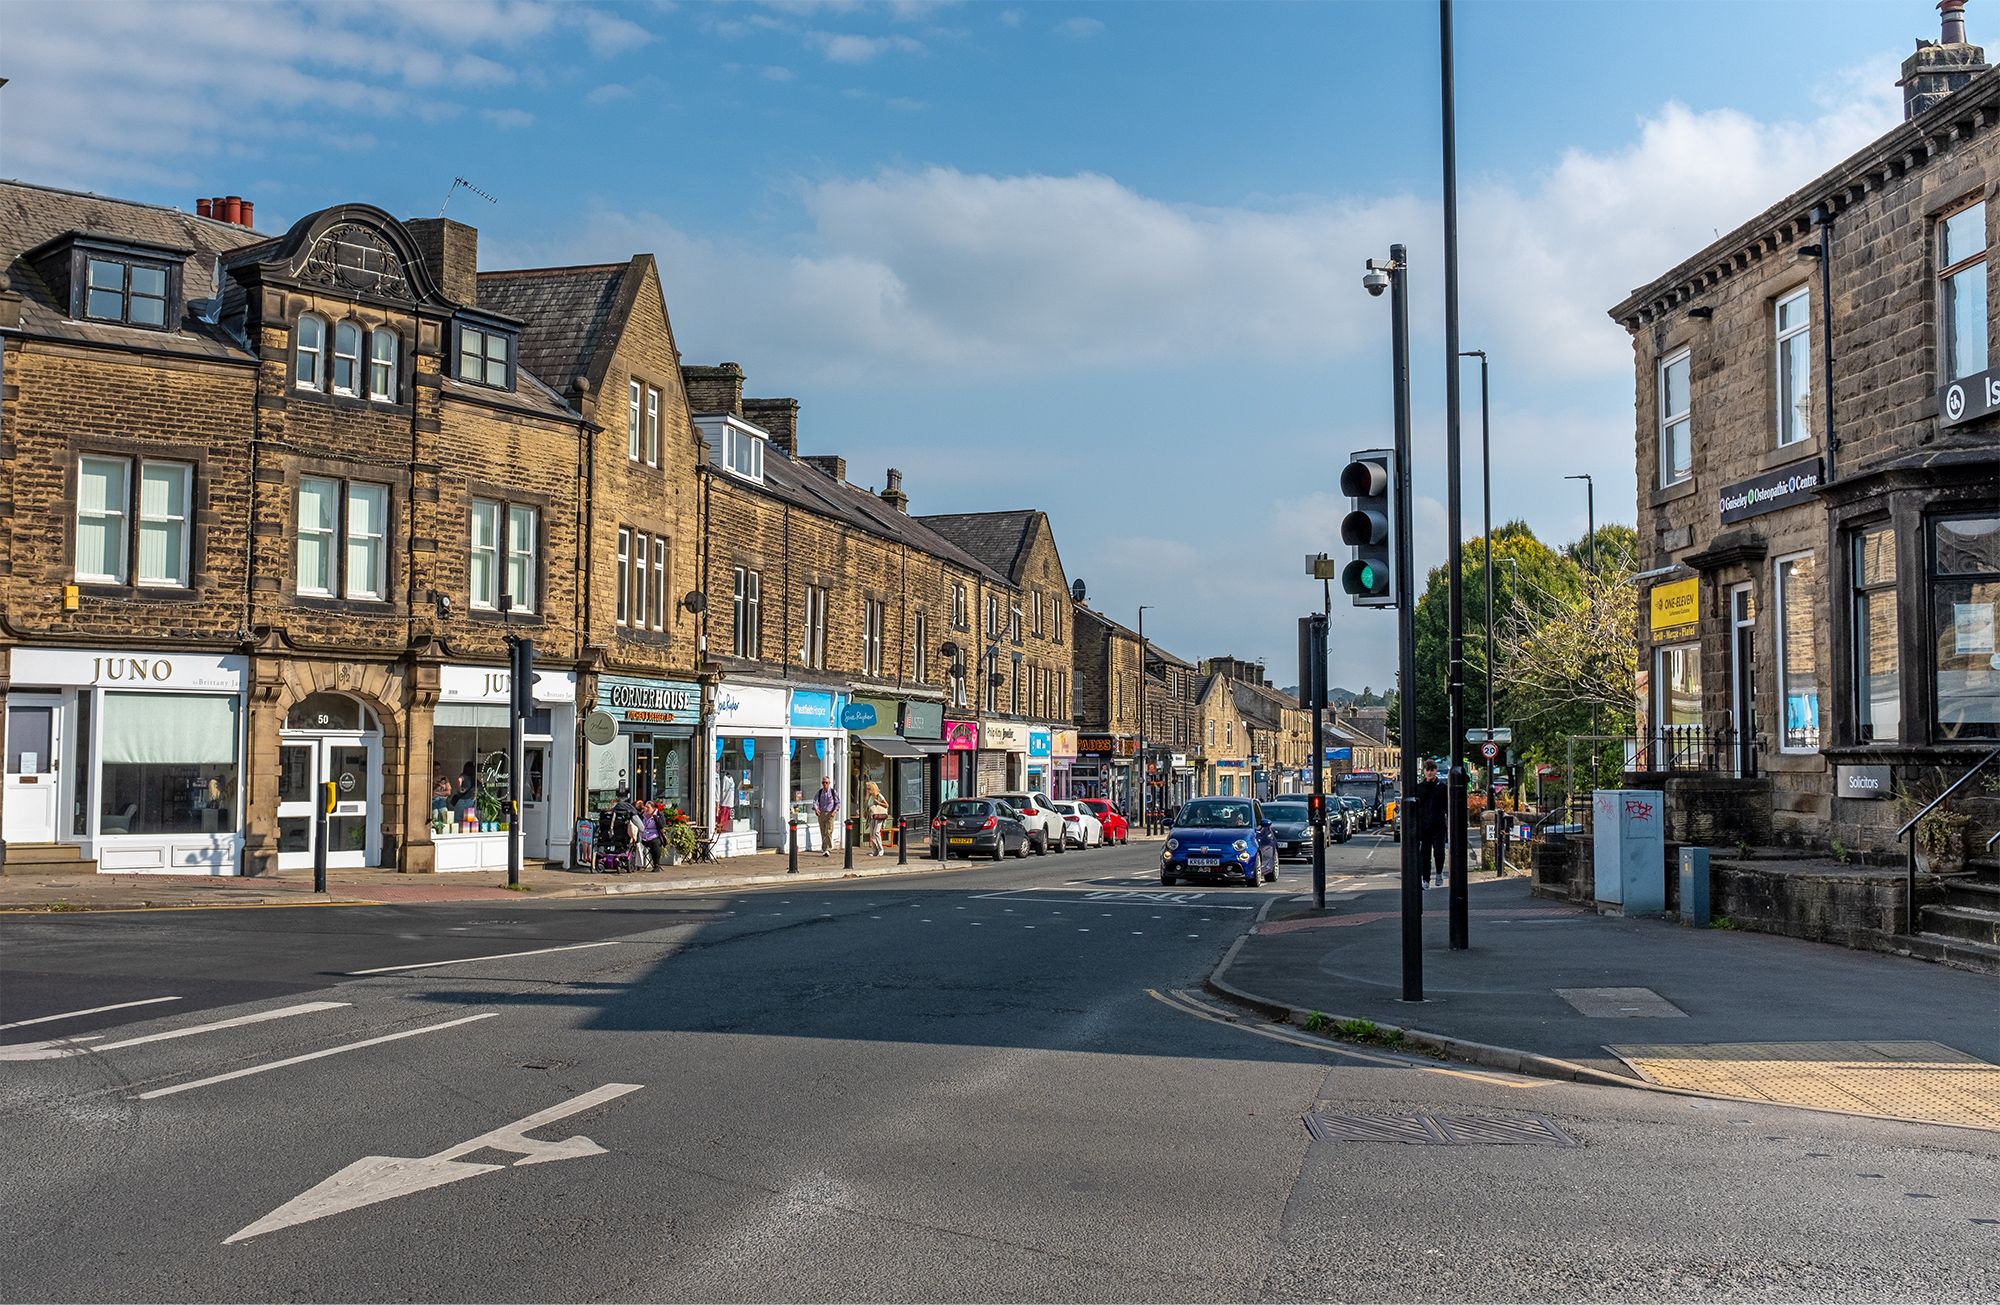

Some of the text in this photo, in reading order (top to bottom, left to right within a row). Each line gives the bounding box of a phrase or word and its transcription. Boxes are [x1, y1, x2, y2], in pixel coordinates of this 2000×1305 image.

[1725, 474, 1818, 508] Guiseley Osteopathic Centre
[1665, 594, 1694, 609] ONE-ELEVEN
[90, 657, 173, 684] JUNO
[198, 679, 228, 687] Brittany
[612, 686, 690, 710] CORNERHOUSE
[318, 715, 329, 724] 50
[1848, 775, 1879, 789] Solicitors
